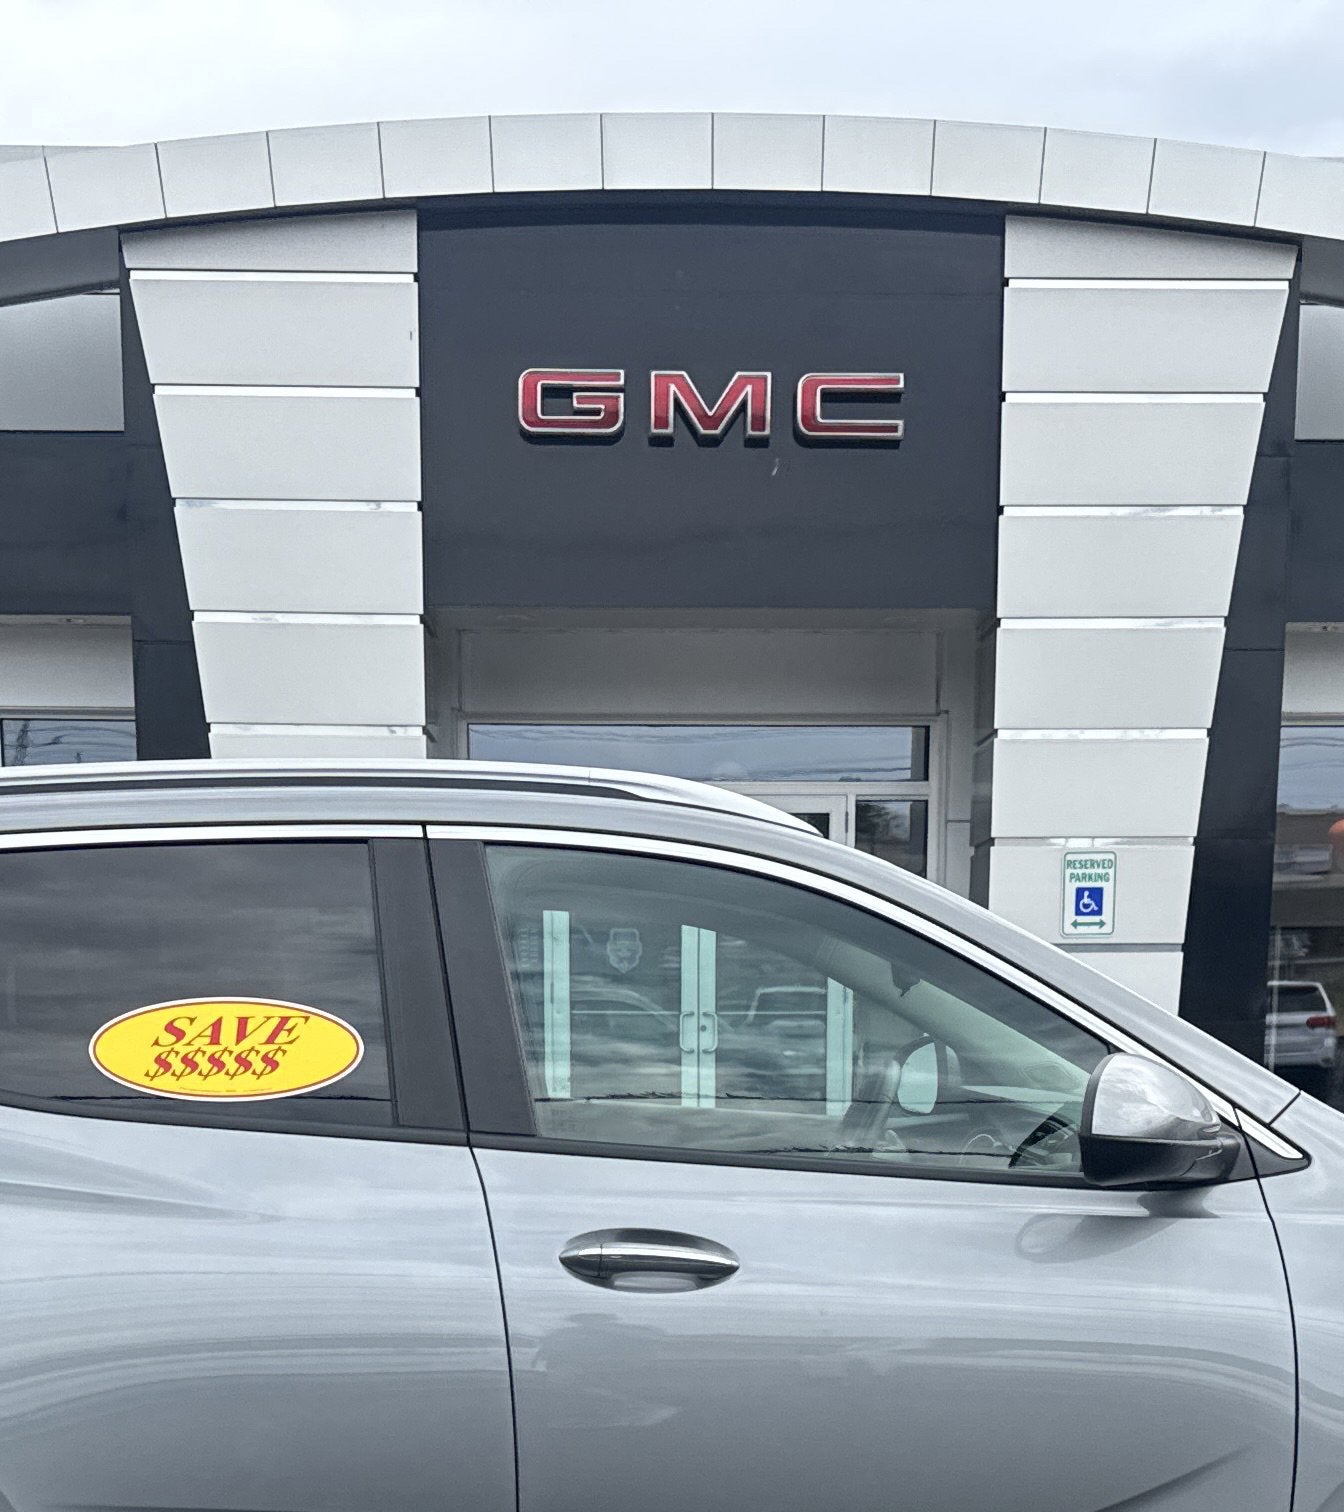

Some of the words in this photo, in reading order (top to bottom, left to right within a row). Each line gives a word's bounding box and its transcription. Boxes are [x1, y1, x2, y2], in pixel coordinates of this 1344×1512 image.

[517, 367, 905, 447] GMC
[1067, 859, 1113, 869] RESERVED
[1069, 872, 1110, 883] PARKING
[150, 1015, 311, 1048] SAVE
[143, 1046, 288, 1082] $$$$$
